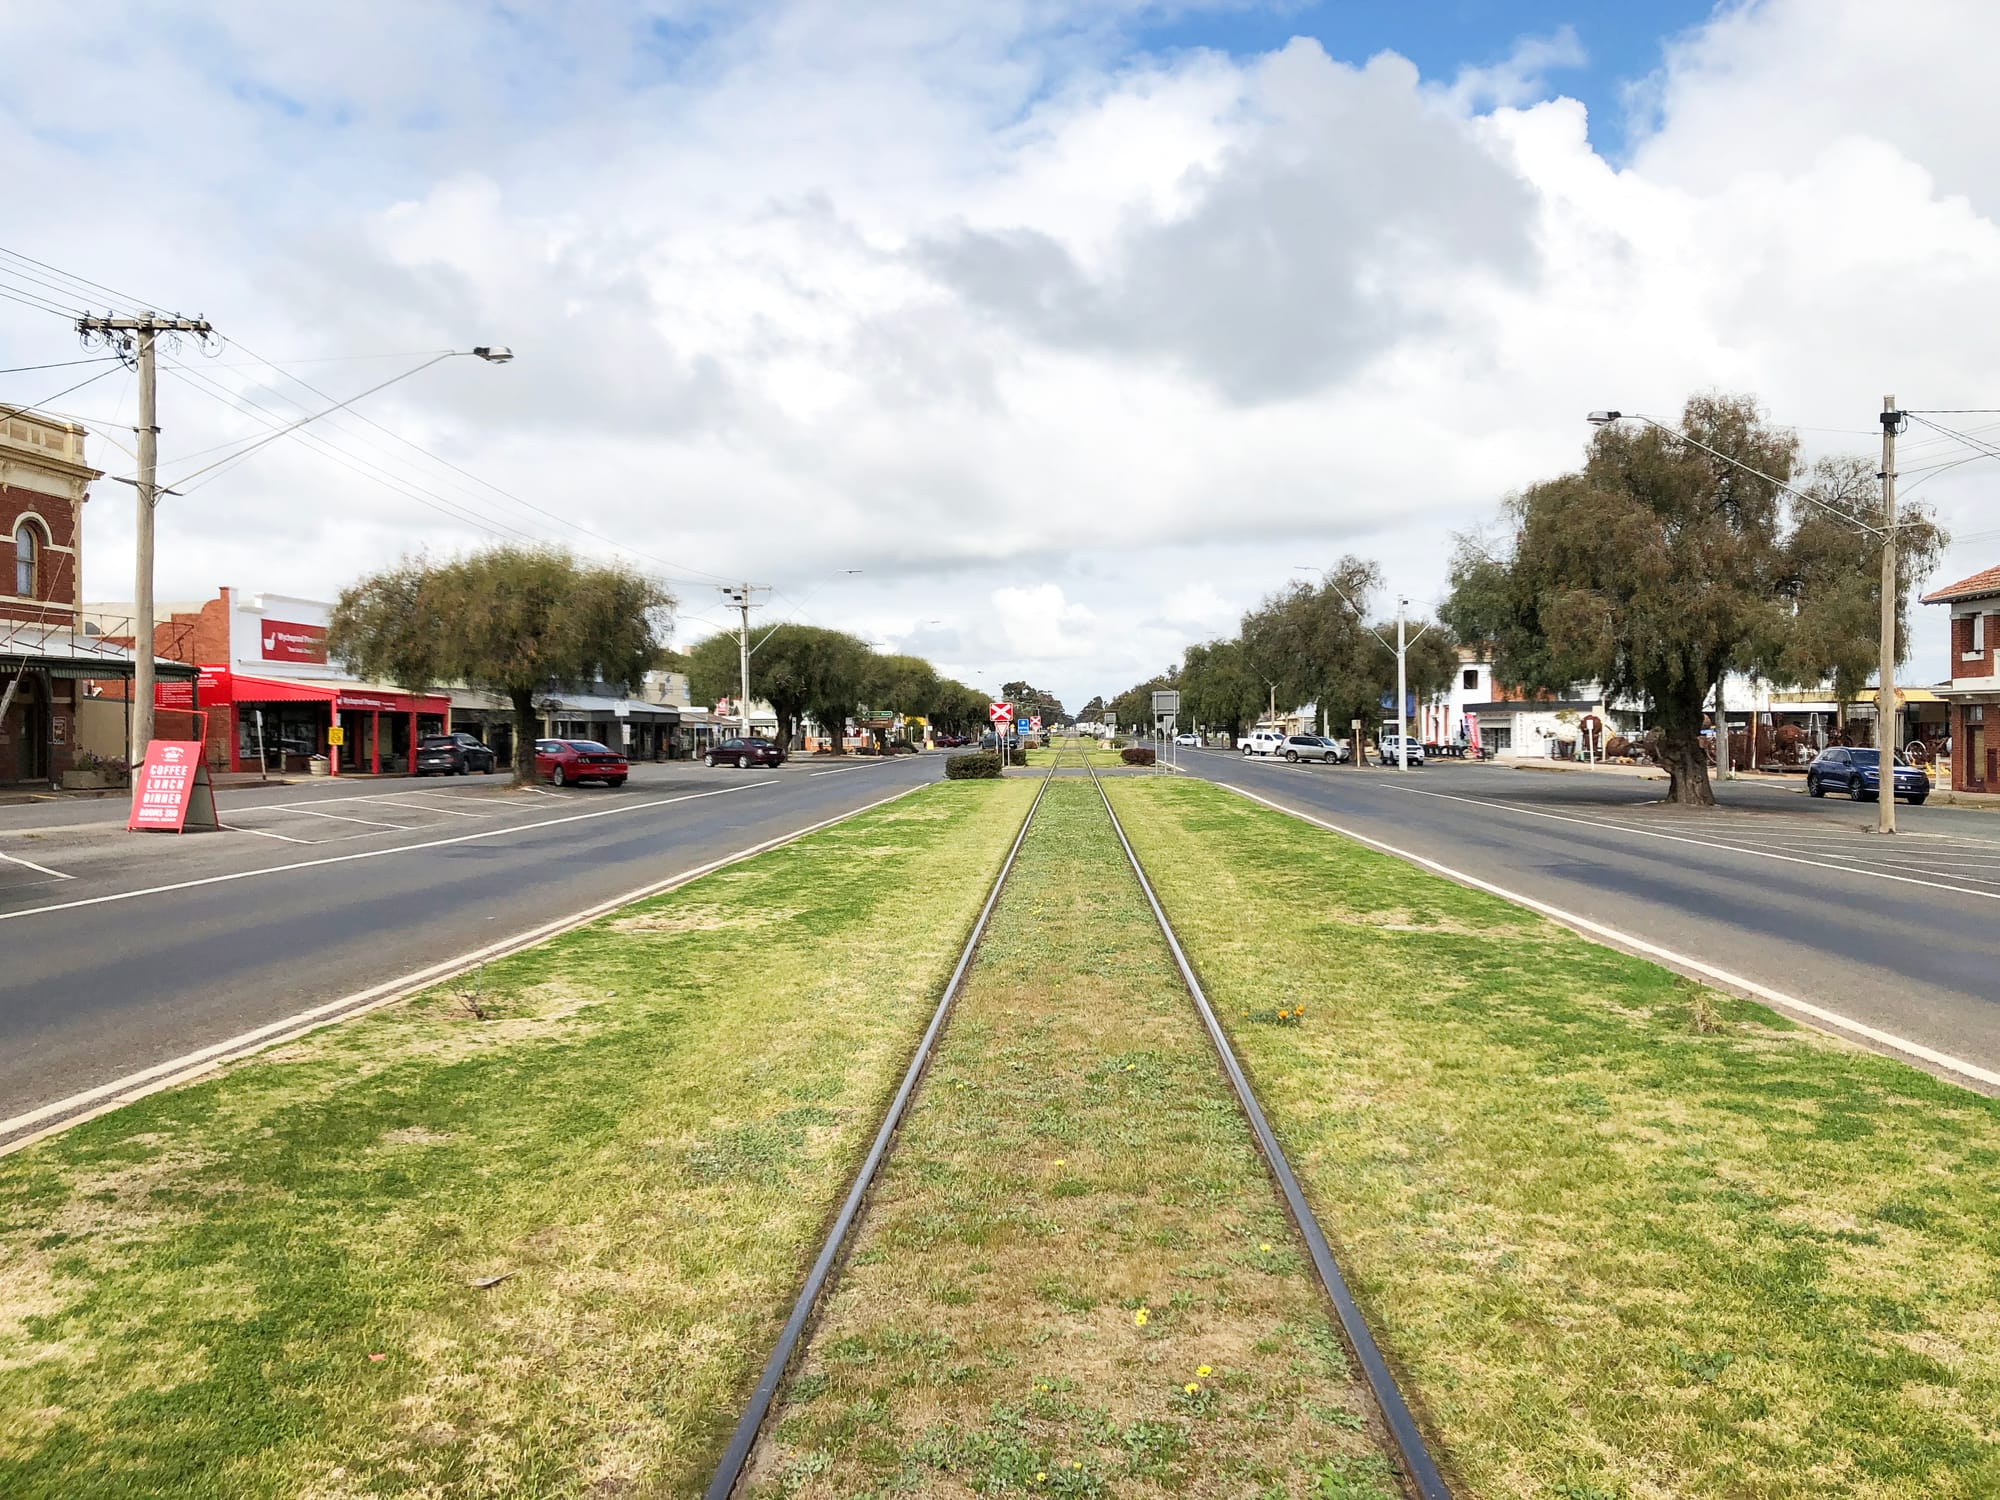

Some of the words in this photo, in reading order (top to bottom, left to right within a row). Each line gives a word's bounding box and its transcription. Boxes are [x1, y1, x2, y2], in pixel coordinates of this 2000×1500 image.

[150, 765, 188, 776] COFFEE
[146, 779, 185, 790] LUNCH
[143, 793, 182, 804] DINNER
